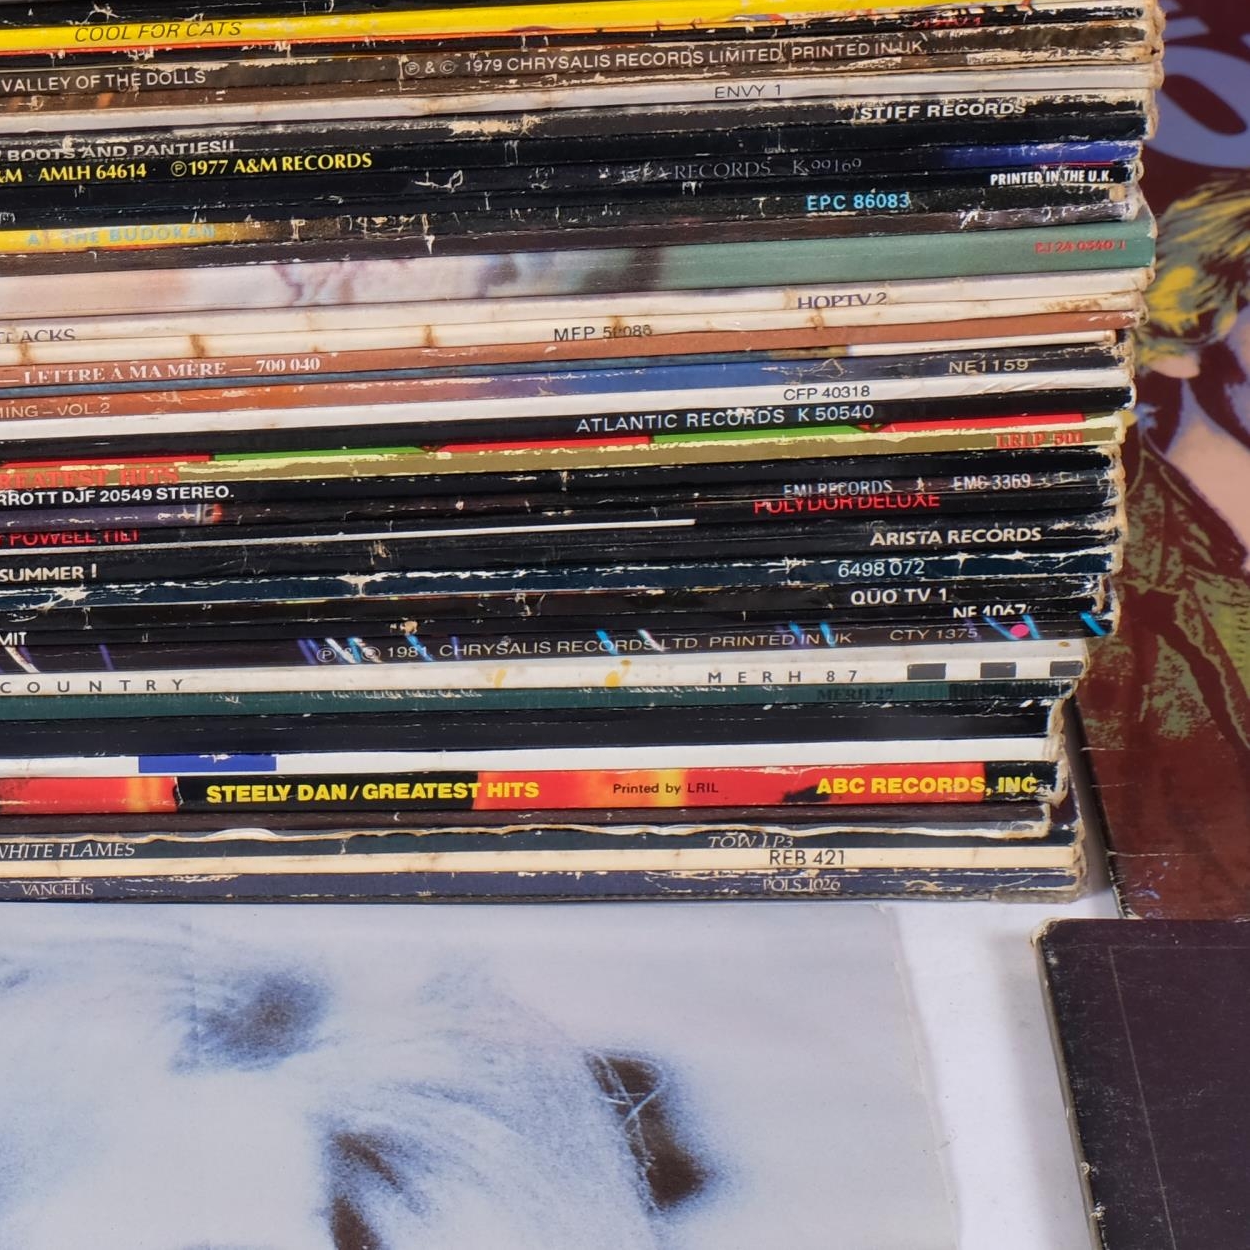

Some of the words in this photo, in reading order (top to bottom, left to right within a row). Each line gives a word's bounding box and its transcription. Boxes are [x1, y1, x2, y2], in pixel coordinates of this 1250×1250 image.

[75, 26, 131, 43] COOL
[138, 24, 178, 40] FOR
[186, 21, 242, 38] CATS
[1, 78, 72, 93] VALLEY
[76, 75, 101, 89] OF
[104, 74, 141, 89] THE
[146, 71, 206, 86] DOLLS
[714, 86, 765, 99] ENVY
[774, 85, 782, 96] 1
[861, 105, 920, 120] STIFF
[927, 102, 1026, 117] RECORDS
[807, 194, 846, 211] EPC
[853, 193, 910, 209] 86083
[784, 388, 818, 401] CFP
[822, 386, 870, 399] 40318
[577, 414, 677, 433] ATLANTIC
[686, 408, 785, 429] RECORDS
[798, 407, 812, 421] K
[816, 405, 874, 420] 50540
[62, 488, 96, 504] DJF
[100, 486, 152, 502] 20549
[870, 531, 940, 547] ARISTA
[948, 528, 1041, 544] RECORDS
[838, 563, 885, 578] 6498
[890, 560, 925, 575] 072
[0, 679, 184, 694] COUNTRY
[207, 784, 291, 804] STEELY
[487, 782, 539, 799] HITS
[613, 782, 659, 794] Printed
[664, 782, 681, 796] by
[770, 850, 806, 866] REB
[814, 850, 845, 864] 421
[22, 884, 93, 896] VANGELIS
